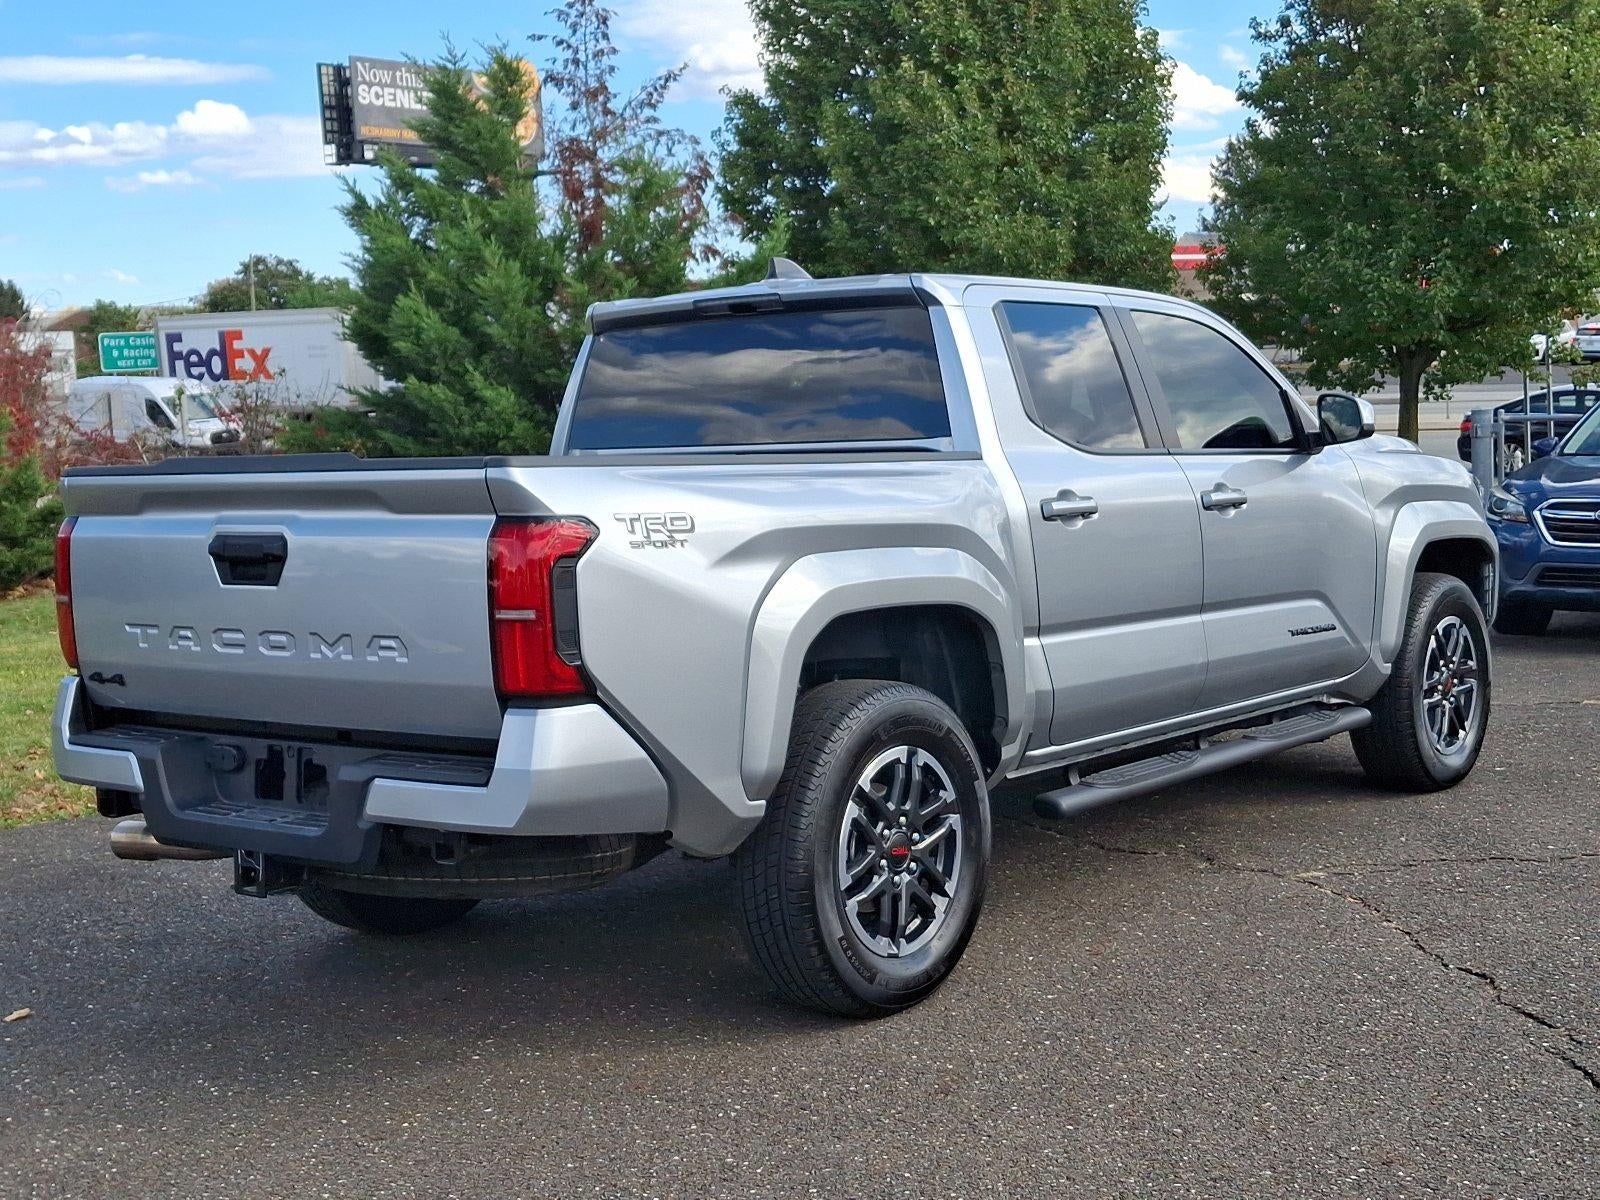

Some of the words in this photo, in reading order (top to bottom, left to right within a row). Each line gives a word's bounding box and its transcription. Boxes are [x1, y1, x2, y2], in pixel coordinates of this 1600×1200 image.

[356, 61, 393, 85] Now
[396, 67, 423, 88] this
[103, 337, 125, 347] Parx
[129, 336, 155, 346] Casin
[112, 348, 119, 358] &
[123, 347, 156, 358] Racing
[165, 328, 275, 382] FedEx
[117, 359, 134, 367] NEXT
[137, 359, 152, 367] EXIT
[613, 512, 696, 540] TRD
[629, 539, 689, 549] SPORT
[124, 623, 409, 664] TACOMA
